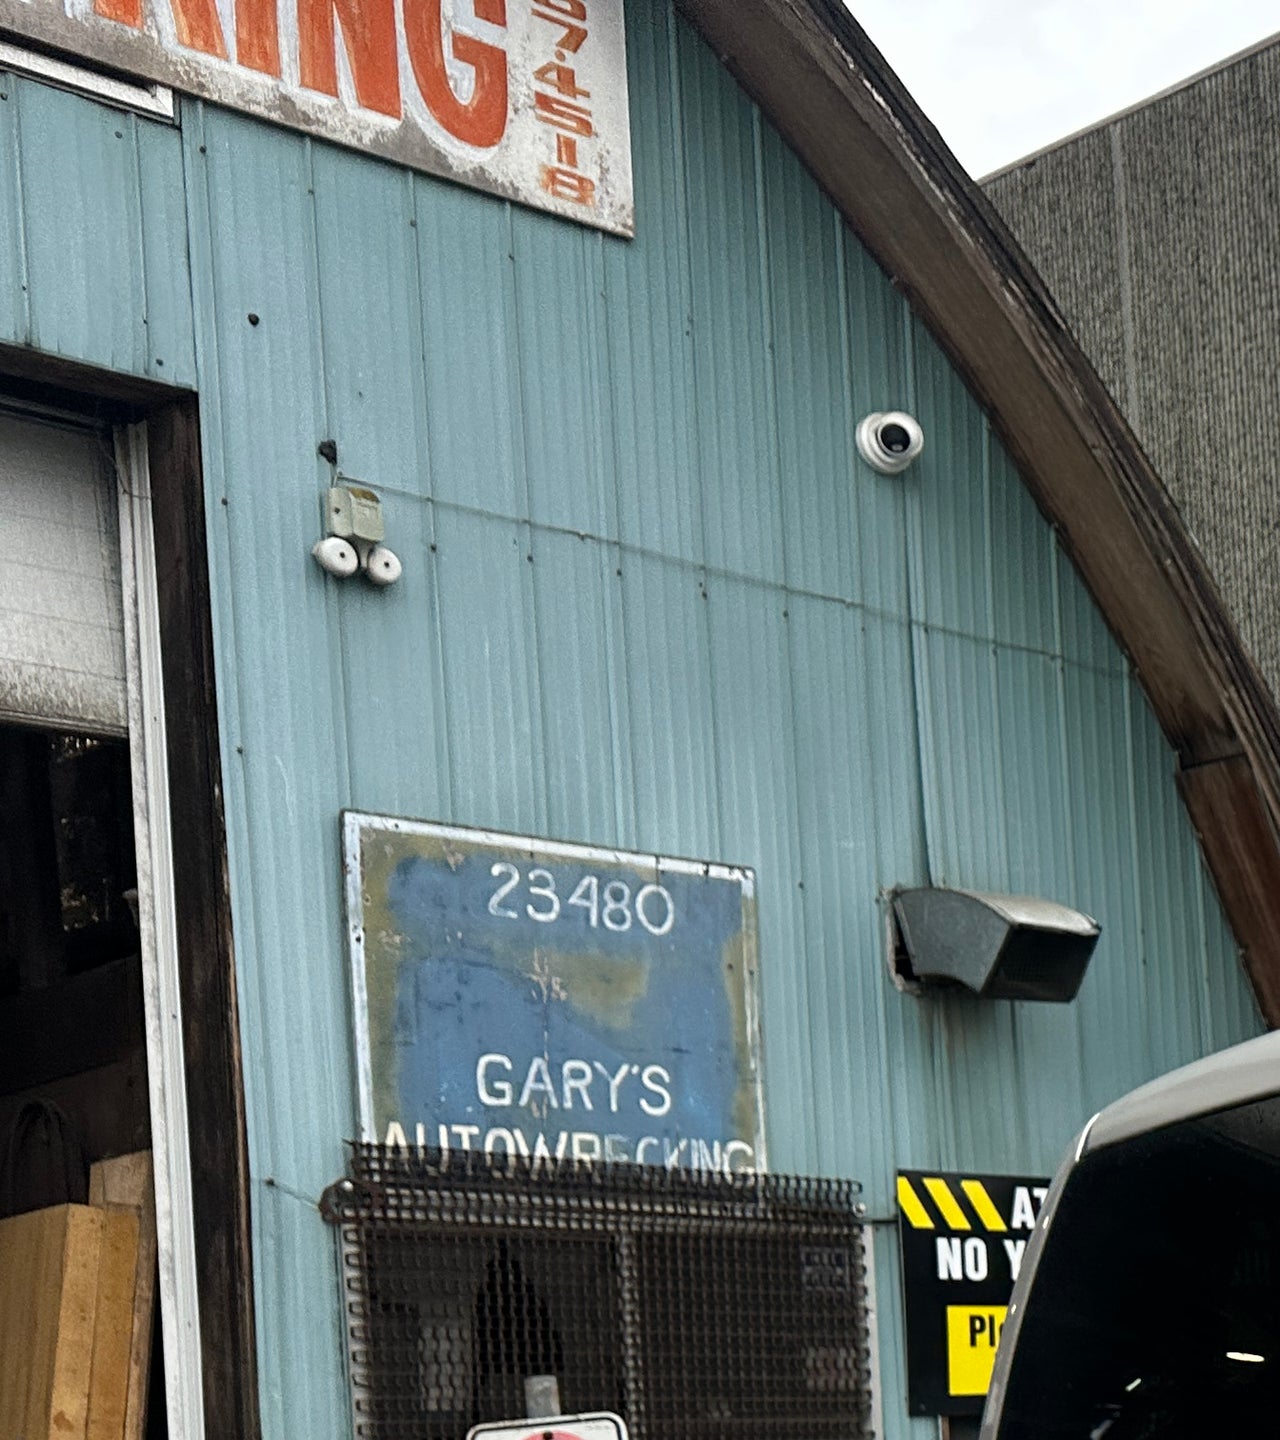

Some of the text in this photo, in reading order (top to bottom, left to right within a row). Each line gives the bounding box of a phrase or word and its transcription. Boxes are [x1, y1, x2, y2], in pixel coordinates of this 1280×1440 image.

[487, 861, 675, 936] 23480
[476, 1053, 672, 1117] GARY'S
[935, 1236, 988, 1282] NO
[969, 1314, 1005, 1348] Pl
